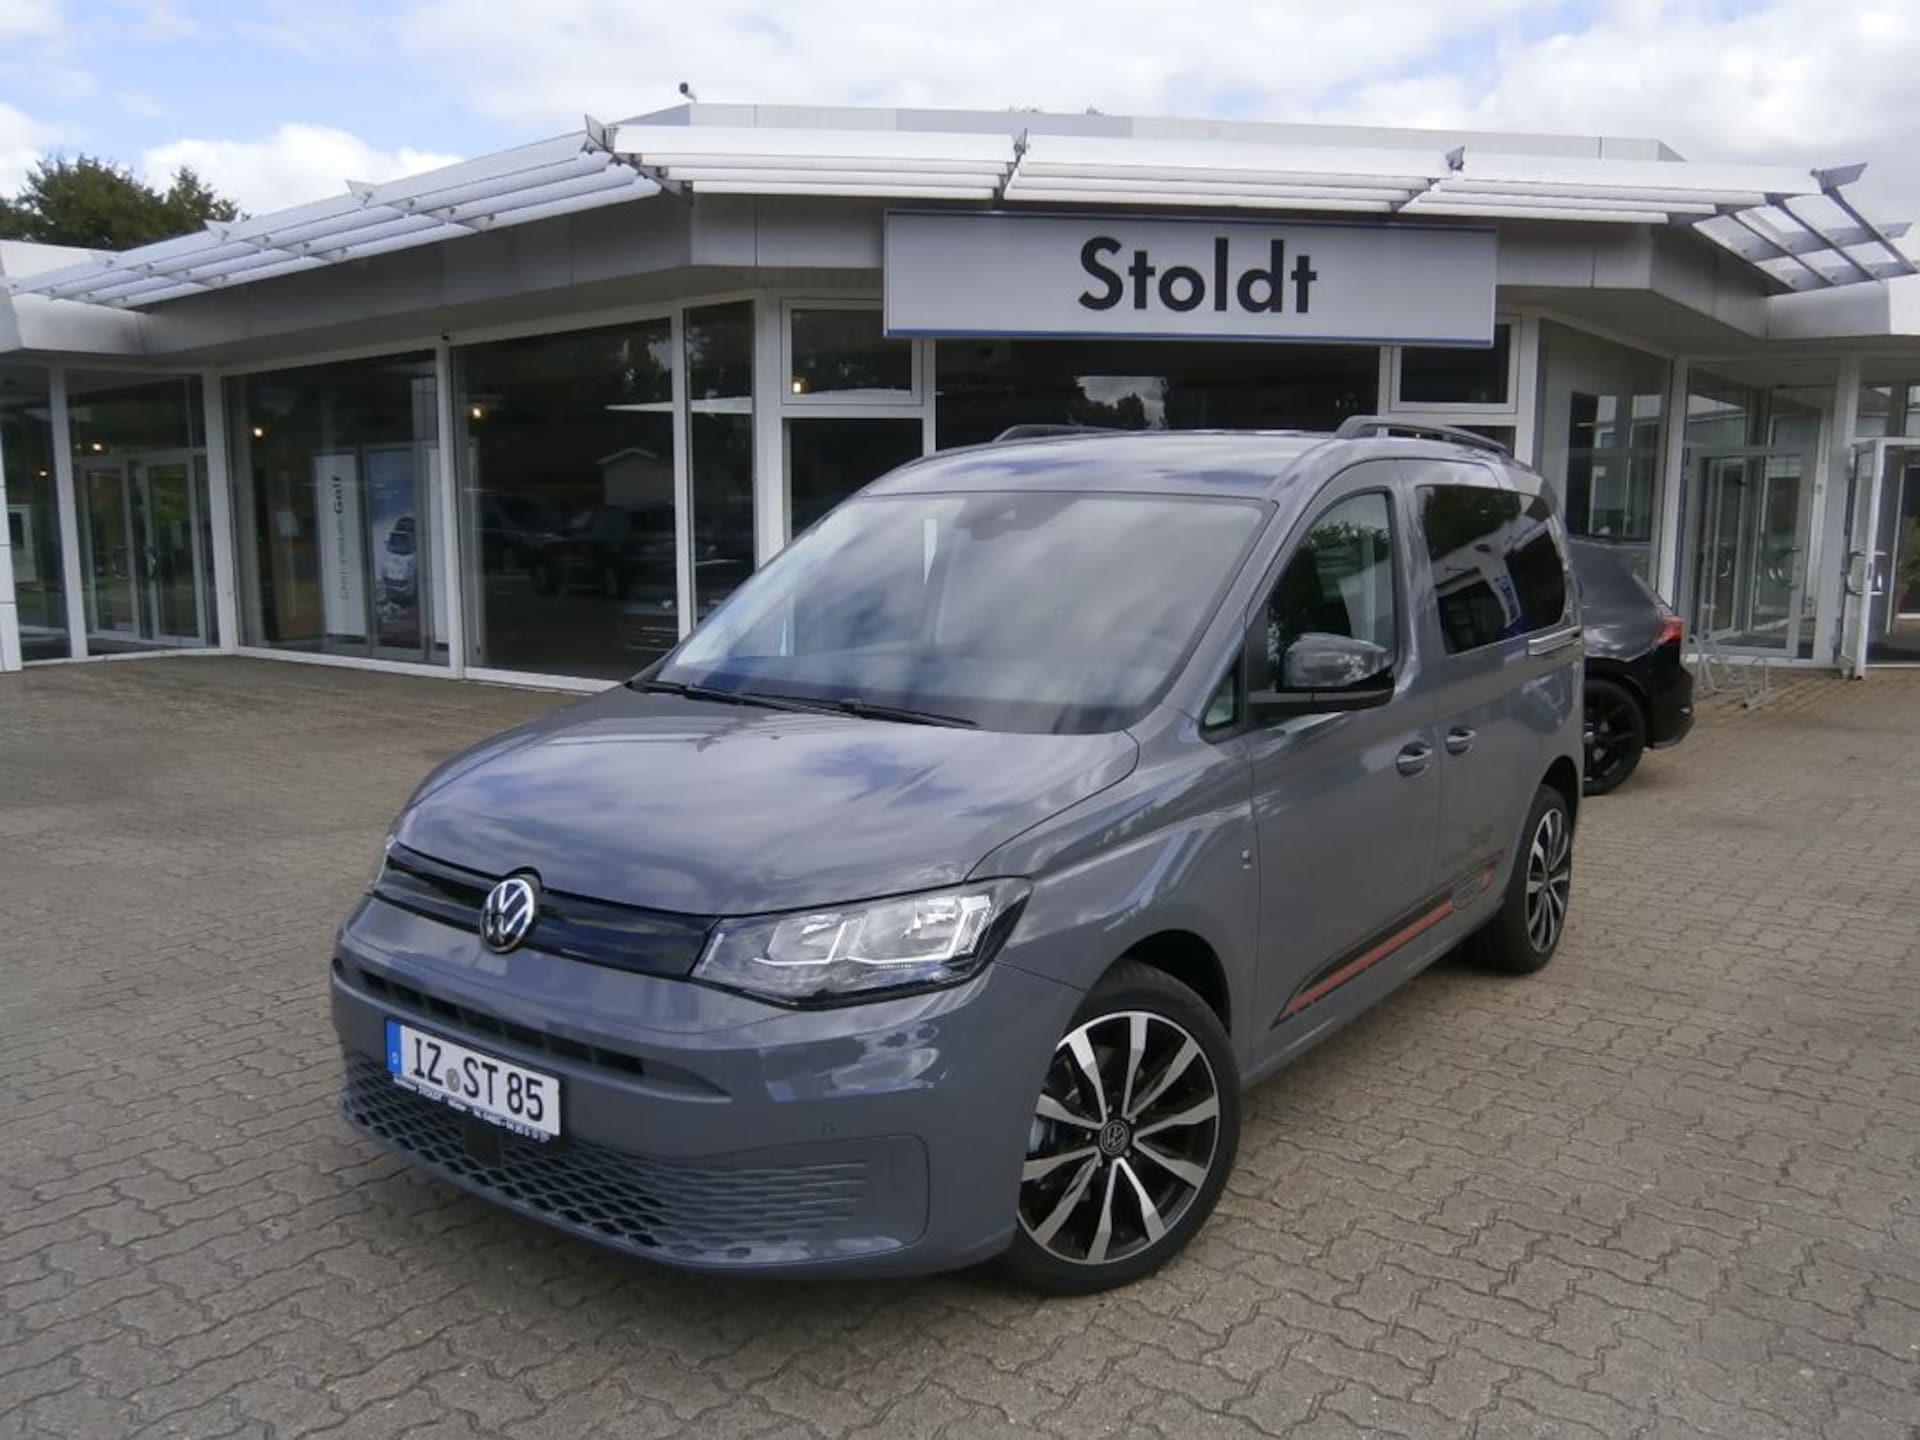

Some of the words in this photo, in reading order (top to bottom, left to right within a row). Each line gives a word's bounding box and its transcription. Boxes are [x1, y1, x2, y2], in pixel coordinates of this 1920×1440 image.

[1079, 235, 1318, 313] Stoldt
[482, 880, 533, 949] VW
[413, 1038, 442, 1086] IZ
[463, 1057, 499, 1105] ST
[507, 1072, 544, 1123] 85
